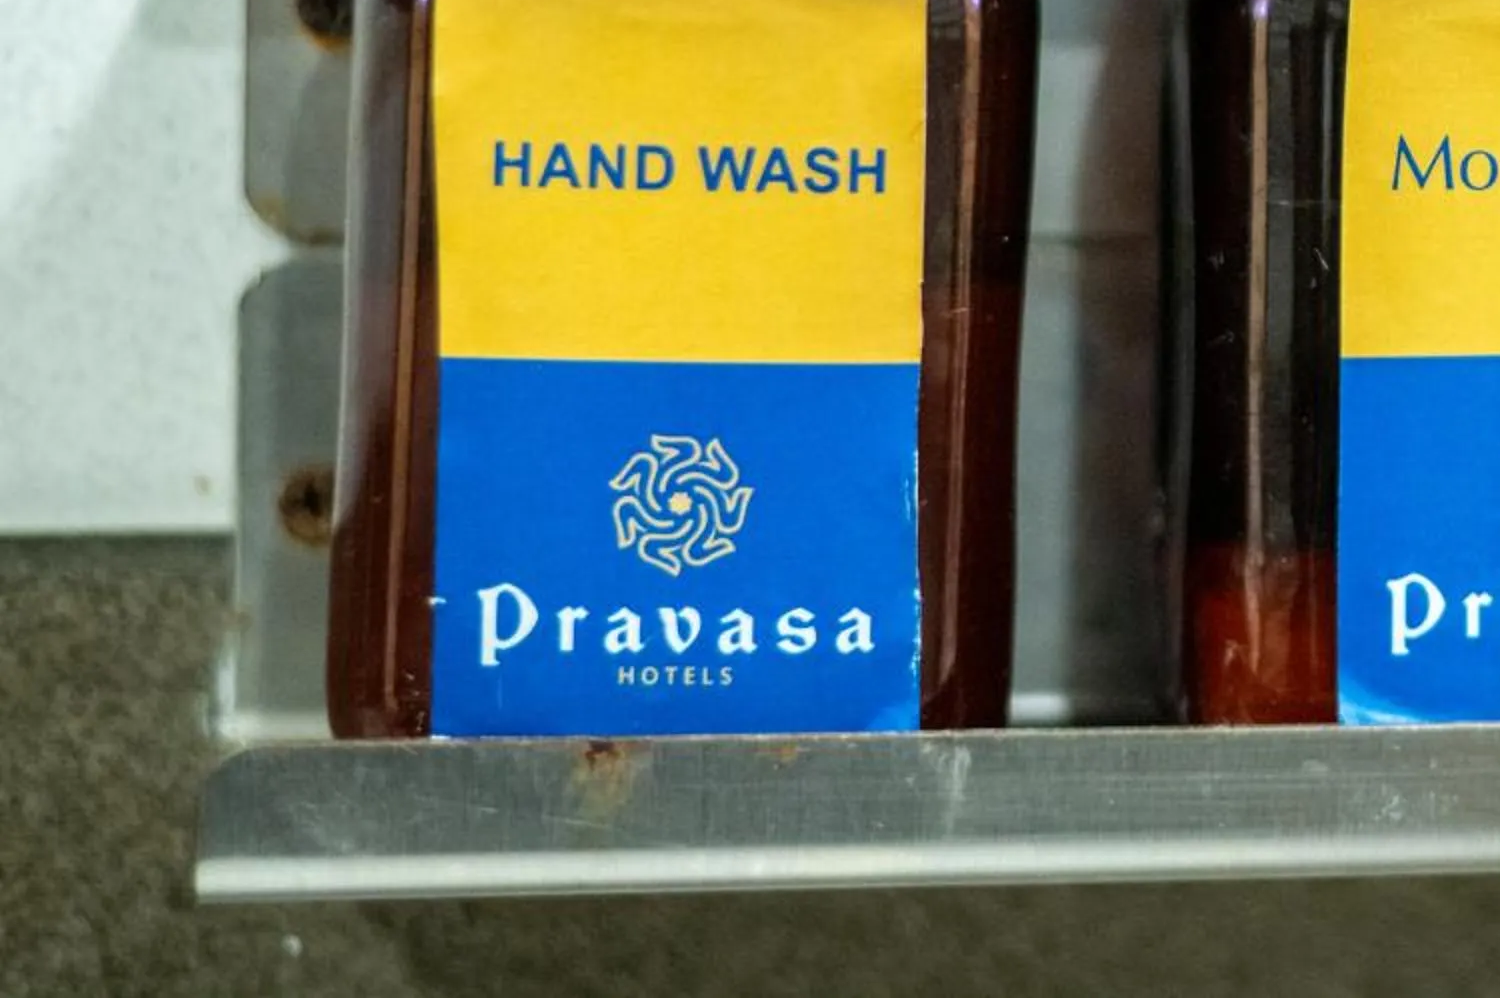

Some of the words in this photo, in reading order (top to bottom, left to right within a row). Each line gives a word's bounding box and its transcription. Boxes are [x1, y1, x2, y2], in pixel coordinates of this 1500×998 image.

[492, 140, 676, 192] HAND
[697, 145, 888, 195] WASH
[477, 582, 876, 667] Pravasa
[617, 666, 734, 686] HOTELS
